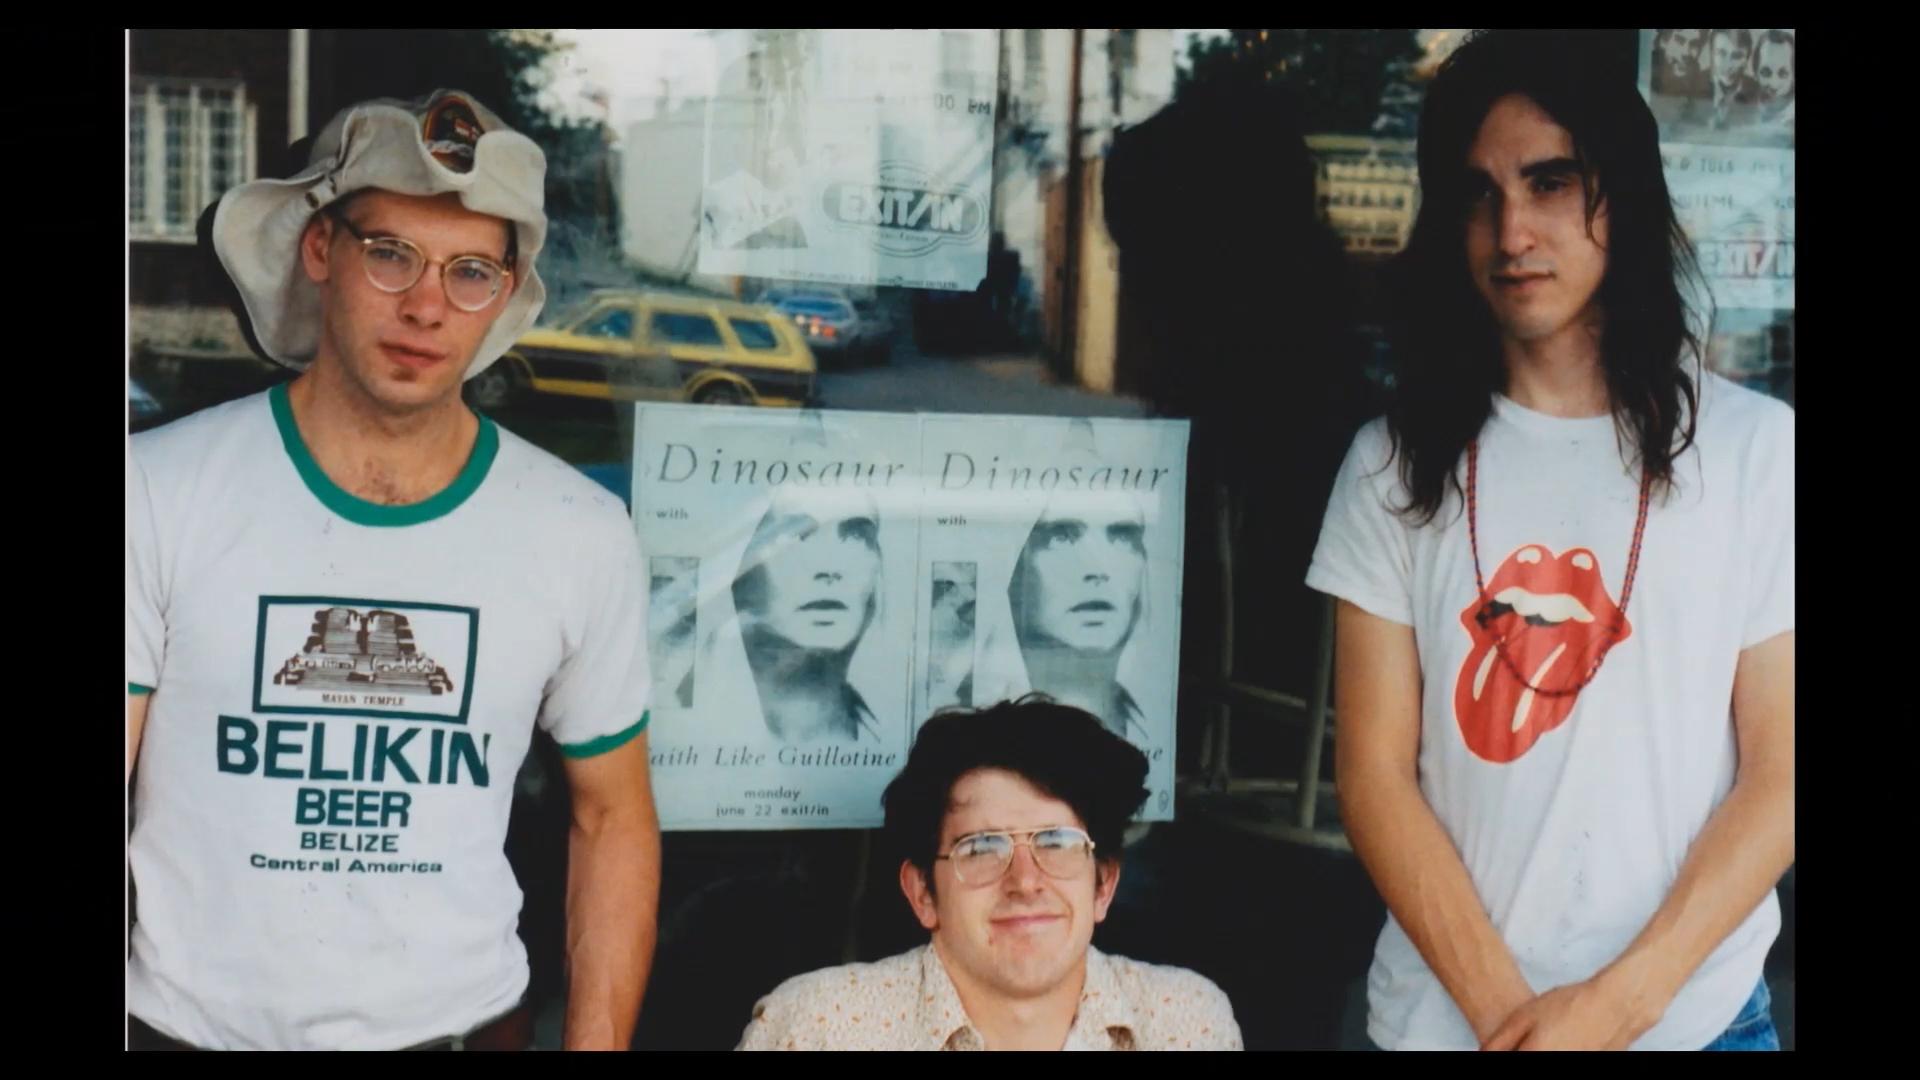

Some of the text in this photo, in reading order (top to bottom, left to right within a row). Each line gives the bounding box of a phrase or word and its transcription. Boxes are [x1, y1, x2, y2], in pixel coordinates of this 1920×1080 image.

[657, 443, 905, 487] Dinosaur
[939, 452, 1169, 492] Dinosaur
[655, 508, 689, 520] with
[937, 515, 968, 527] with
[321, 693, 406, 707] MAYAN TEMPLE
[216, 714, 492, 788] BELIKIN
[650, 745, 897, 768] aith Like Guillotine
[744, 786, 801, 801] monday
[295, 787, 412, 828] BEER
[715, 804, 830, 818] june 22 exit/in
[300, 831, 400, 853] BELIZE
[249, 853, 443, 874] Central America
